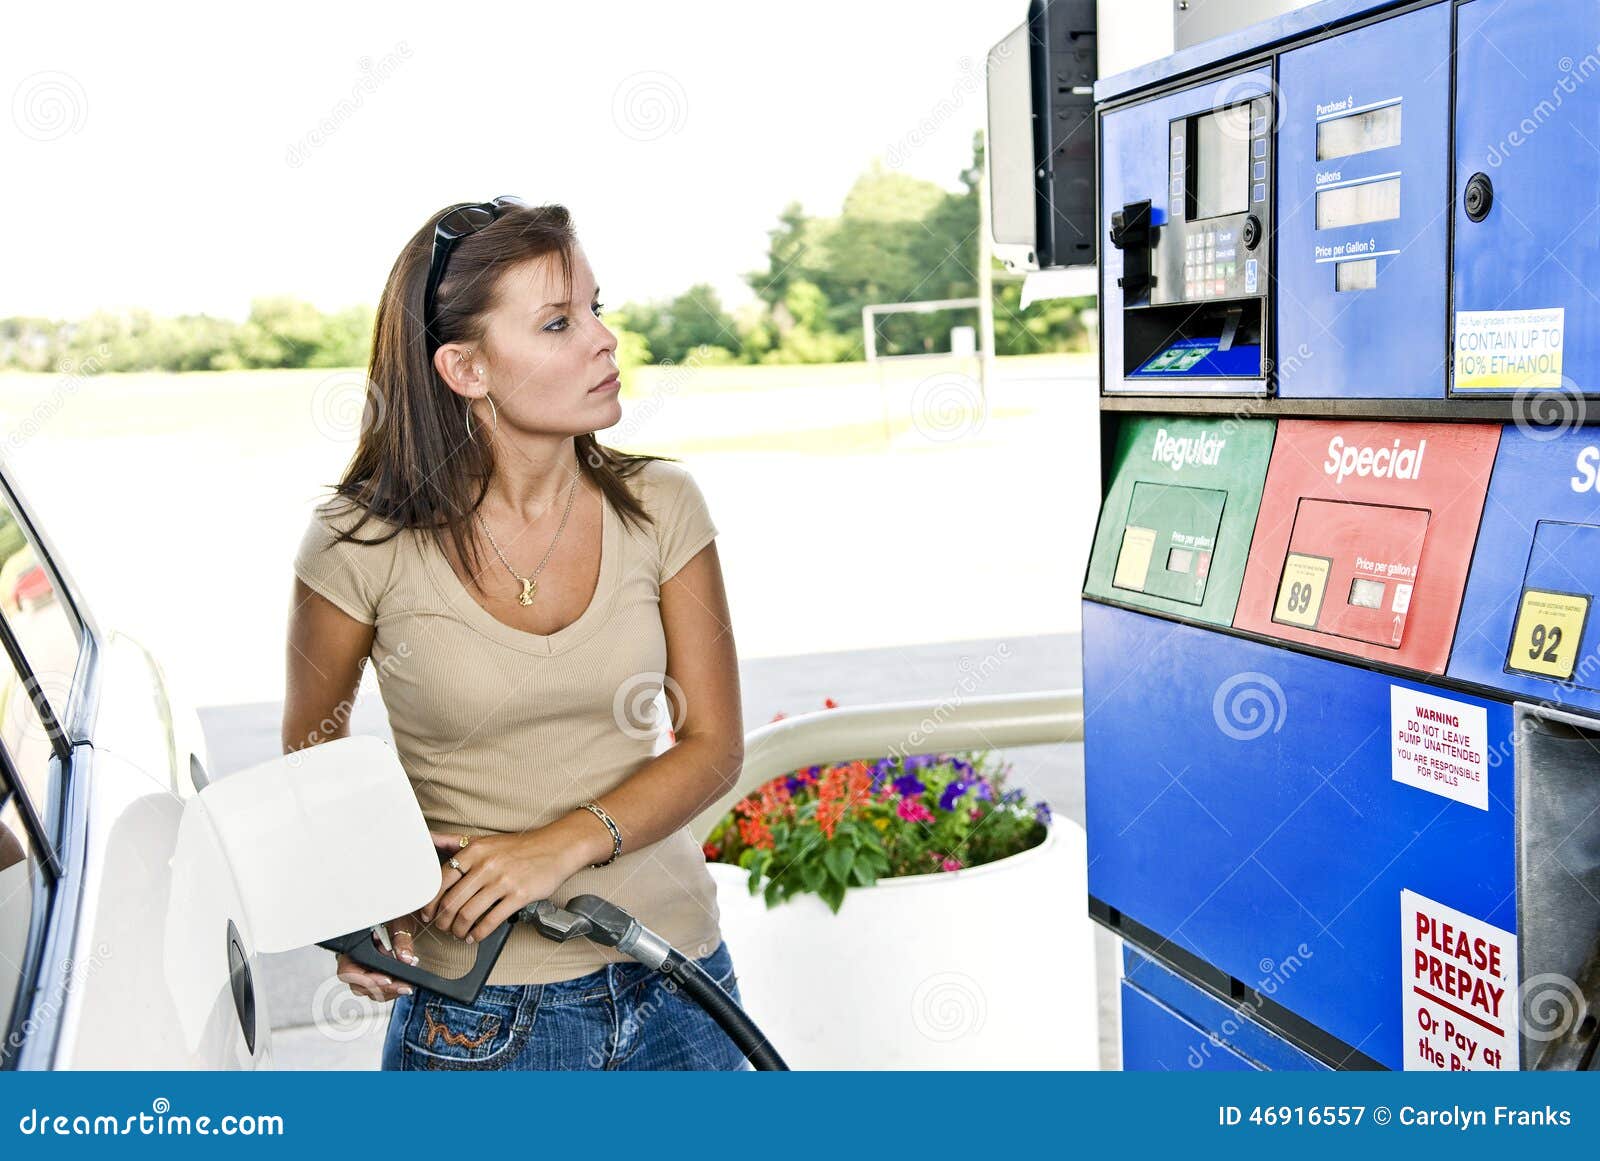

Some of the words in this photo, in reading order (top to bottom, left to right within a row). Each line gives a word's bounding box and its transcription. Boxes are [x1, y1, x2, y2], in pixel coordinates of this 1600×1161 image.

[1316, 100, 1347, 116] Purchase
[1347, 95, 1353, 110] $
[1315, 170, 1341, 184] Gallons
[1315, 245, 1332, 257] Price
[1333, 245, 1345, 259] per
[1345, 241, 1368, 254] Gallon
[1369, 238, 1376, 252] $
[1459, 330, 1518, 351] CONTAIN
[1522, 329, 1539, 349] UP
[1542, 328, 1561, 348] TO
[1459, 355, 1487, 375] 10%
[1491, 353, 1557, 374] ETHANOL
[1152, 429, 1226, 471] Regular
[1324, 435, 1426, 484] Special
[1355, 557, 1374, 571] Price
[1375, 560, 1387, 573] per
[1388, 561, 1411, 577] gallon
[1411, 563, 1417, 578] $
[1288, 581, 1312, 614] 89
[1529, 624, 1562, 663] 92
[1407, 720, 1420, 732] DO
[1422, 724, 1439, 739] NOT
[1442, 729, 1470, 747] LEAVE
[1416, 706, 1459, 728] WARNING
[1399, 731, 1421, 746] PUMP
[1424, 738, 1480, 764] UNATTENDED
[1397, 748, 1411, 760] YOU
[1414, 753, 1428, 765] ARE
[1430, 758, 1480, 782] RESPONSIBLE
[1417, 765, 1431, 777] FOR
[1433, 771, 1458, 787] SPILLS
[1416, 911, 1501, 978] PLEASE
[1414, 948, 1504, 1018] PREPAY
[1418, 1007, 1439, 1035] Or
[1445, 1019, 1478, 1061] Pay
[1483, 1047, 1502, 1069] at
[1418, 1036, 1444, 1069] the
